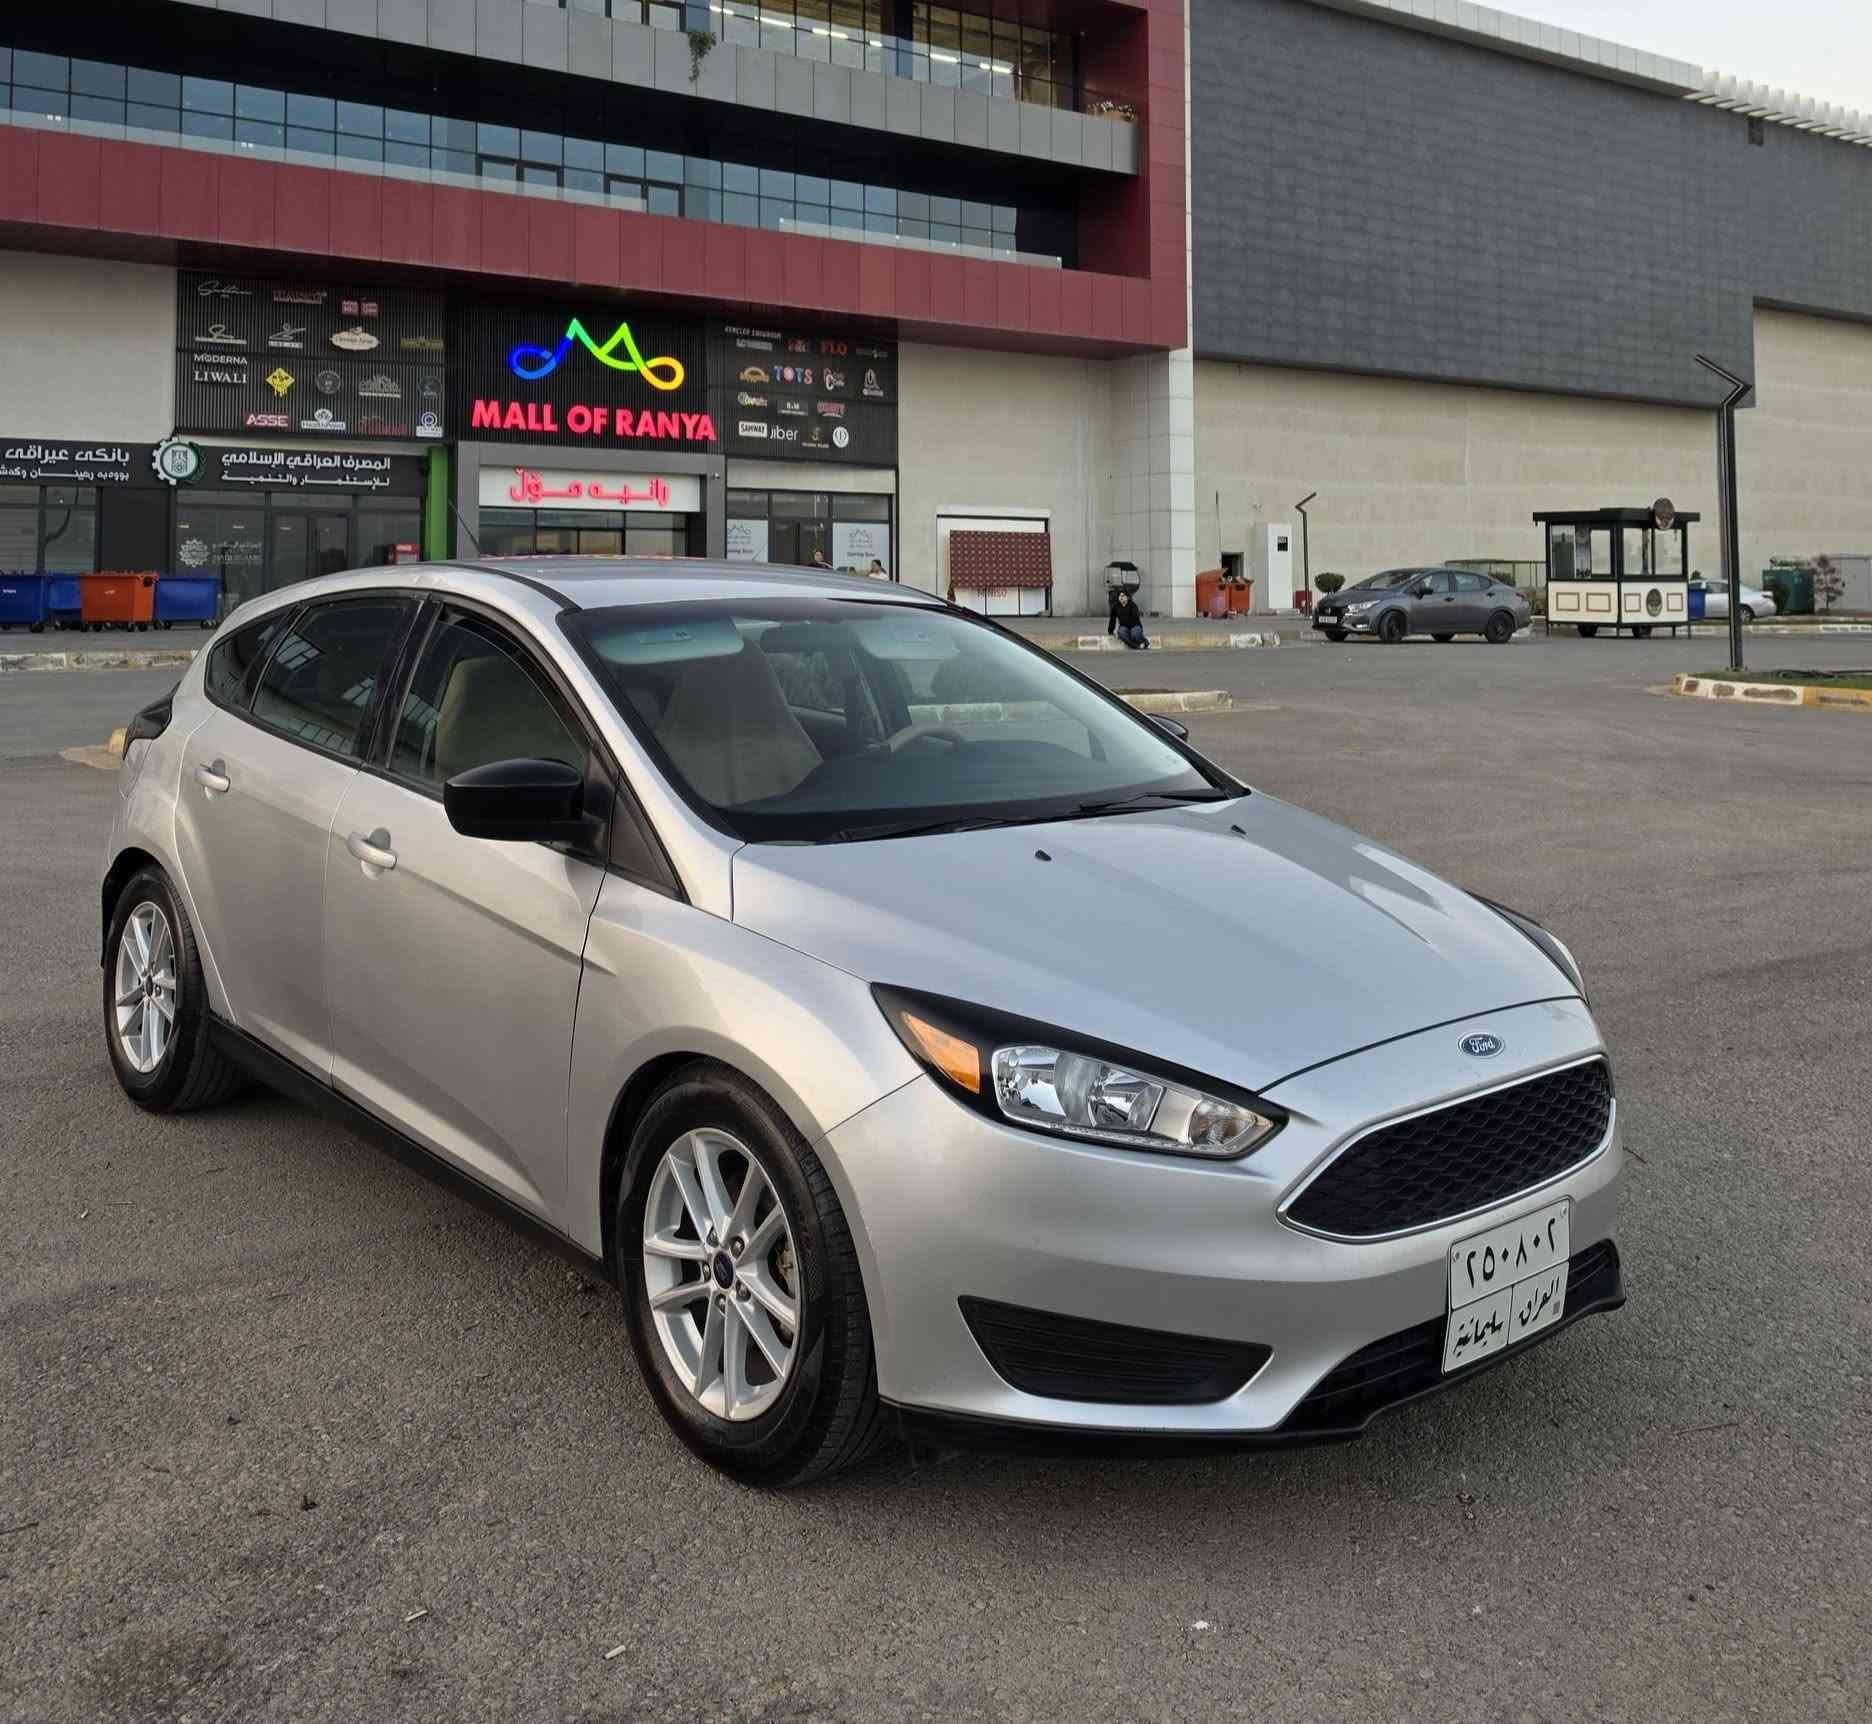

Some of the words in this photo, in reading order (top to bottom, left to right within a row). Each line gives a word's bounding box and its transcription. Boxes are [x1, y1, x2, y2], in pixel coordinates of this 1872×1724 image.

[194, 370, 247, 384] LIWALI
[246, 413, 289, 427] ASSE
[472, 400, 557, 431] MALL
[567, 405, 608, 434] OF
[615, 409, 717, 440] RANYA
[221, 451, 284, 468] الإسلامي
[286, 453, 341, 469] العراقي
[342, 455, 391, 471] المصرف
[1468, 1037, 1496, 1053] Ford
